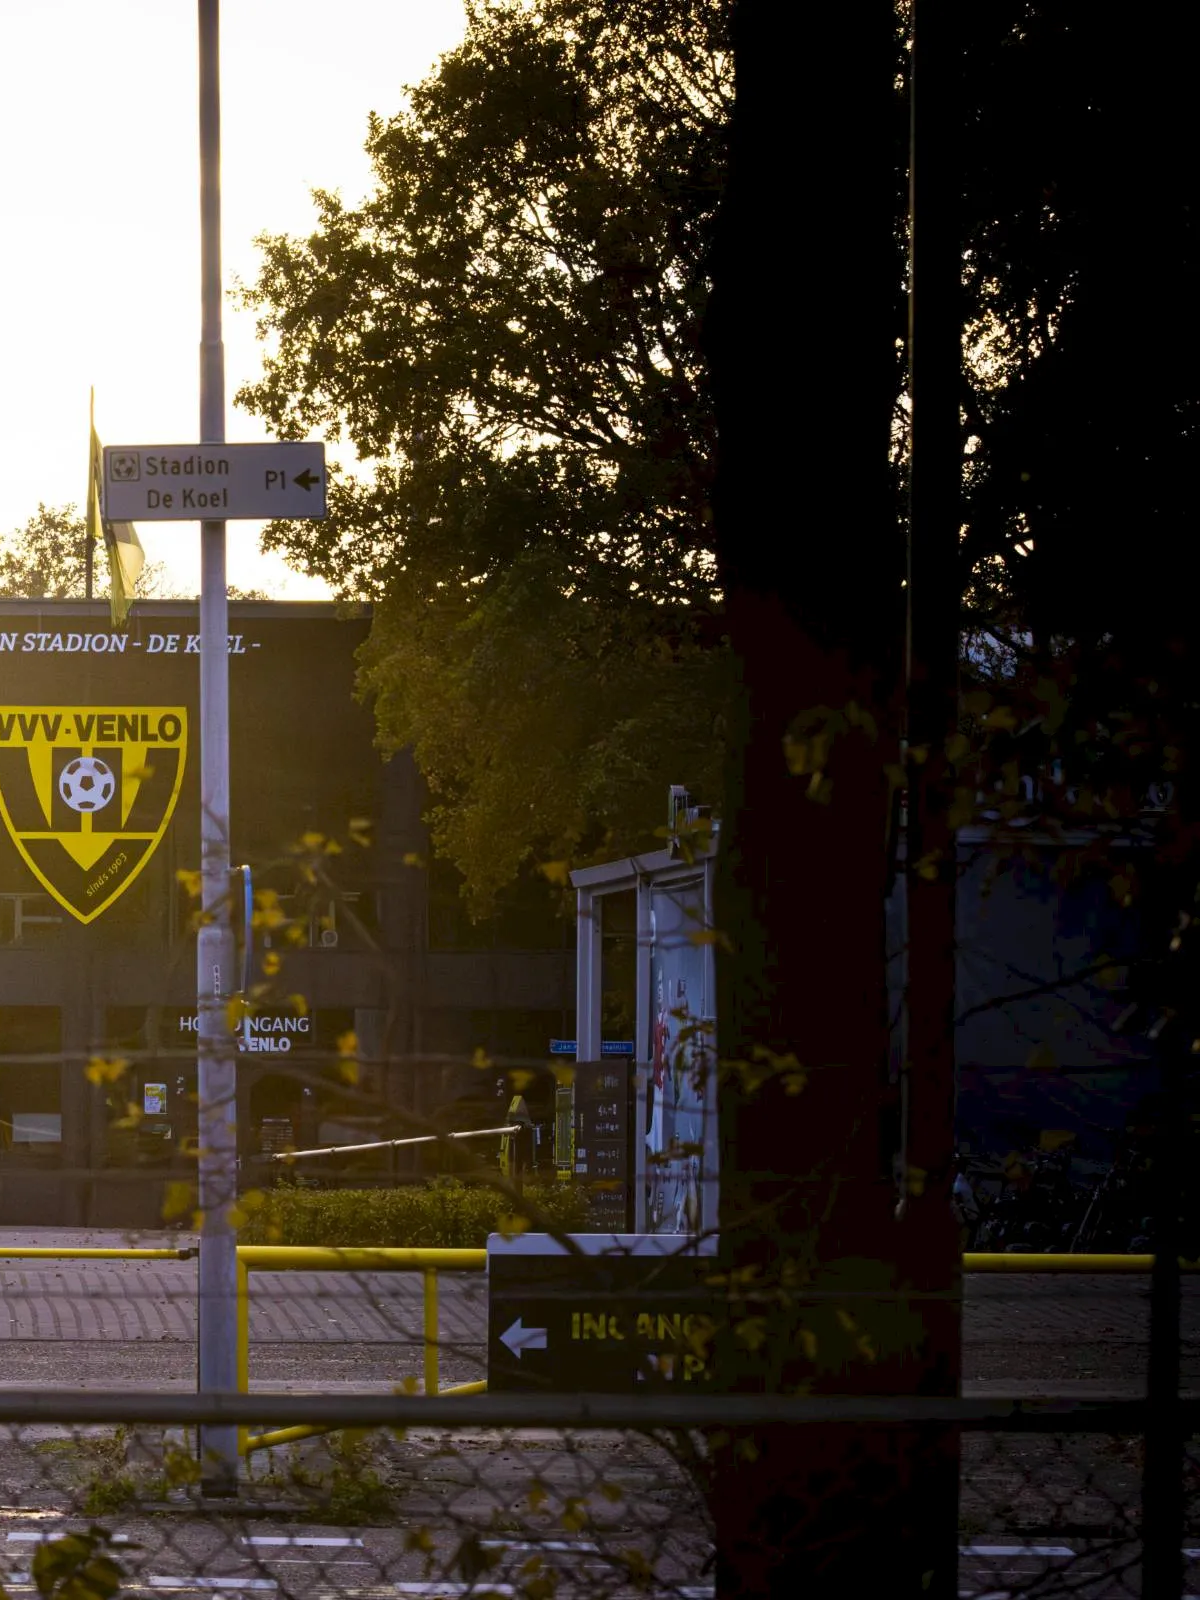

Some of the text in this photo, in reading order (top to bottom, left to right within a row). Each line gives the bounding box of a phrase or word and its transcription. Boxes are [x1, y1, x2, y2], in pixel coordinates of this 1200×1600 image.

[145, 456, 229, 475] Stadion
[265, 470, 286, 490] P1
[147, 488, 228, 508] De Koel
[21, 633, 129, 652] STADION
[147, 634, 181, 653] DE
[184, 635, 246, 653] KL
[86, 852, 127, 896] sinds 1903
